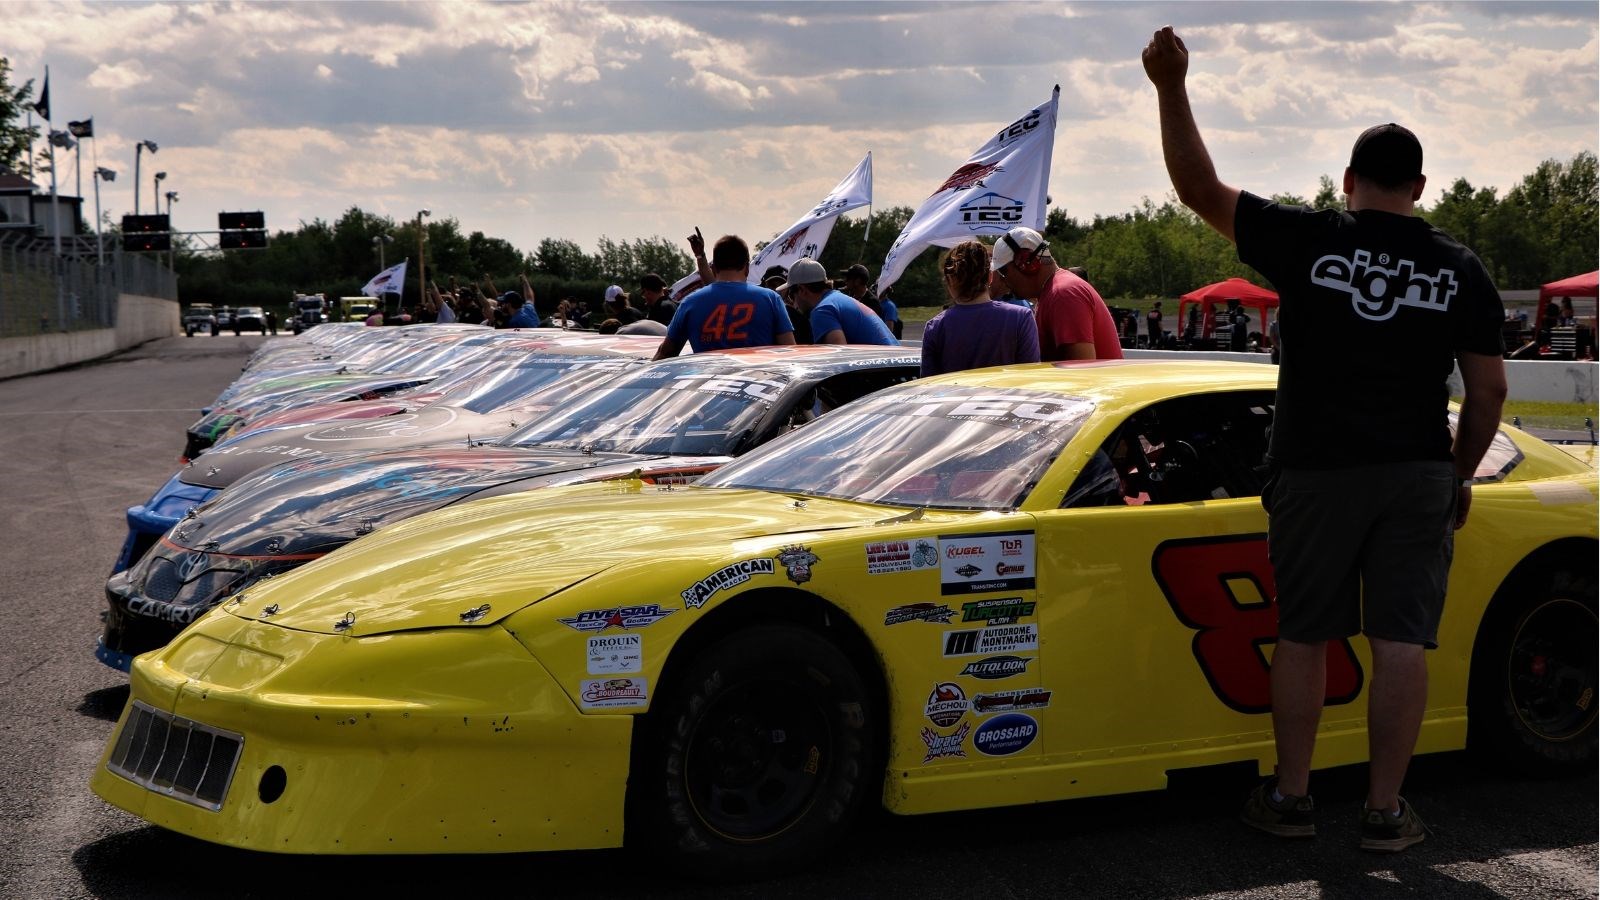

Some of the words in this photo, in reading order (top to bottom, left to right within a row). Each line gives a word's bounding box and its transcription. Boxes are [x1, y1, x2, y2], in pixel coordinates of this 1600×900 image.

[998, 110, 1040, 142] TEC
[959, 206, 1022, 221] TEC
[1311, 249, 1458, 321] eight
[702, 303, 754, 341] 42
[948, 547, 985, 557] KUGEL
[695, 560, 772, 604] AMERICAN
[723, 575, 747, 588] RACER
[127, 597, 200, 624] CAMRY
[976, 599, 1022, 608] SUSPENSION
[577, 610, 614, 622] FIVE
[620, 606, 659, 617] STAR
[1152, 532, 1362, 714] 8
[983, 626, 1031, 637] AUTODROME
[590, 637, 639, 648] DROUIN
[981, 634, 1037, 647] MONTMAGNY
[980, 645, 1016, 653] speedway
[965, 660, 1025, 673] AUTOLOOK
[978, 725, 1034, 744] BROSSARD
